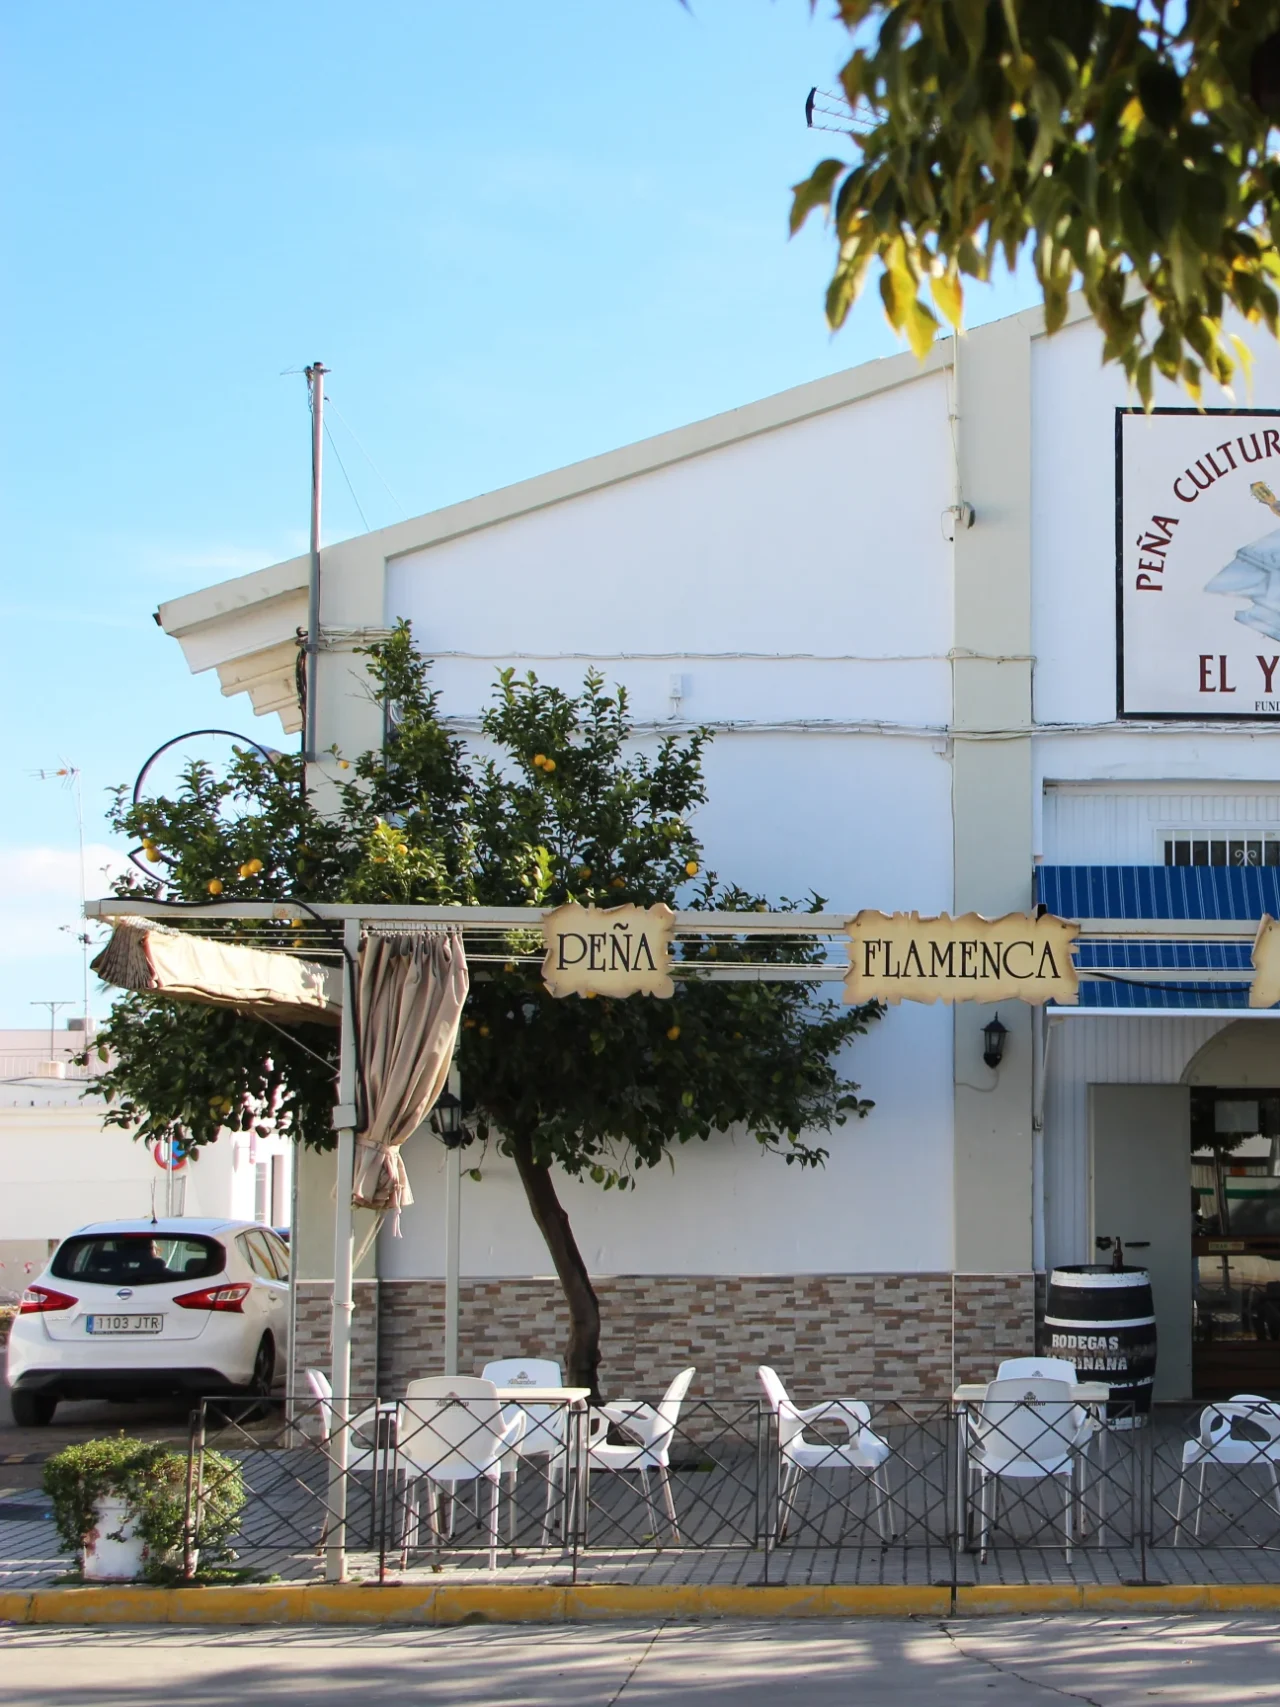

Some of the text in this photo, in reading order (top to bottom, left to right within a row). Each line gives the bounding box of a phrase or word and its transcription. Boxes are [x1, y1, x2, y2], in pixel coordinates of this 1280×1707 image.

[1136, 514, 1180, 591] PEÑA
[1198, 654, 1237, 693] EL
[556, 922, 658, 972] PEÑA
[861, 938, 1062, 980] FLAMENCA
[98, 1316, 159, 1329] 1103 JTR
[1052, 1334, 1119, 1350] BODEGAS
